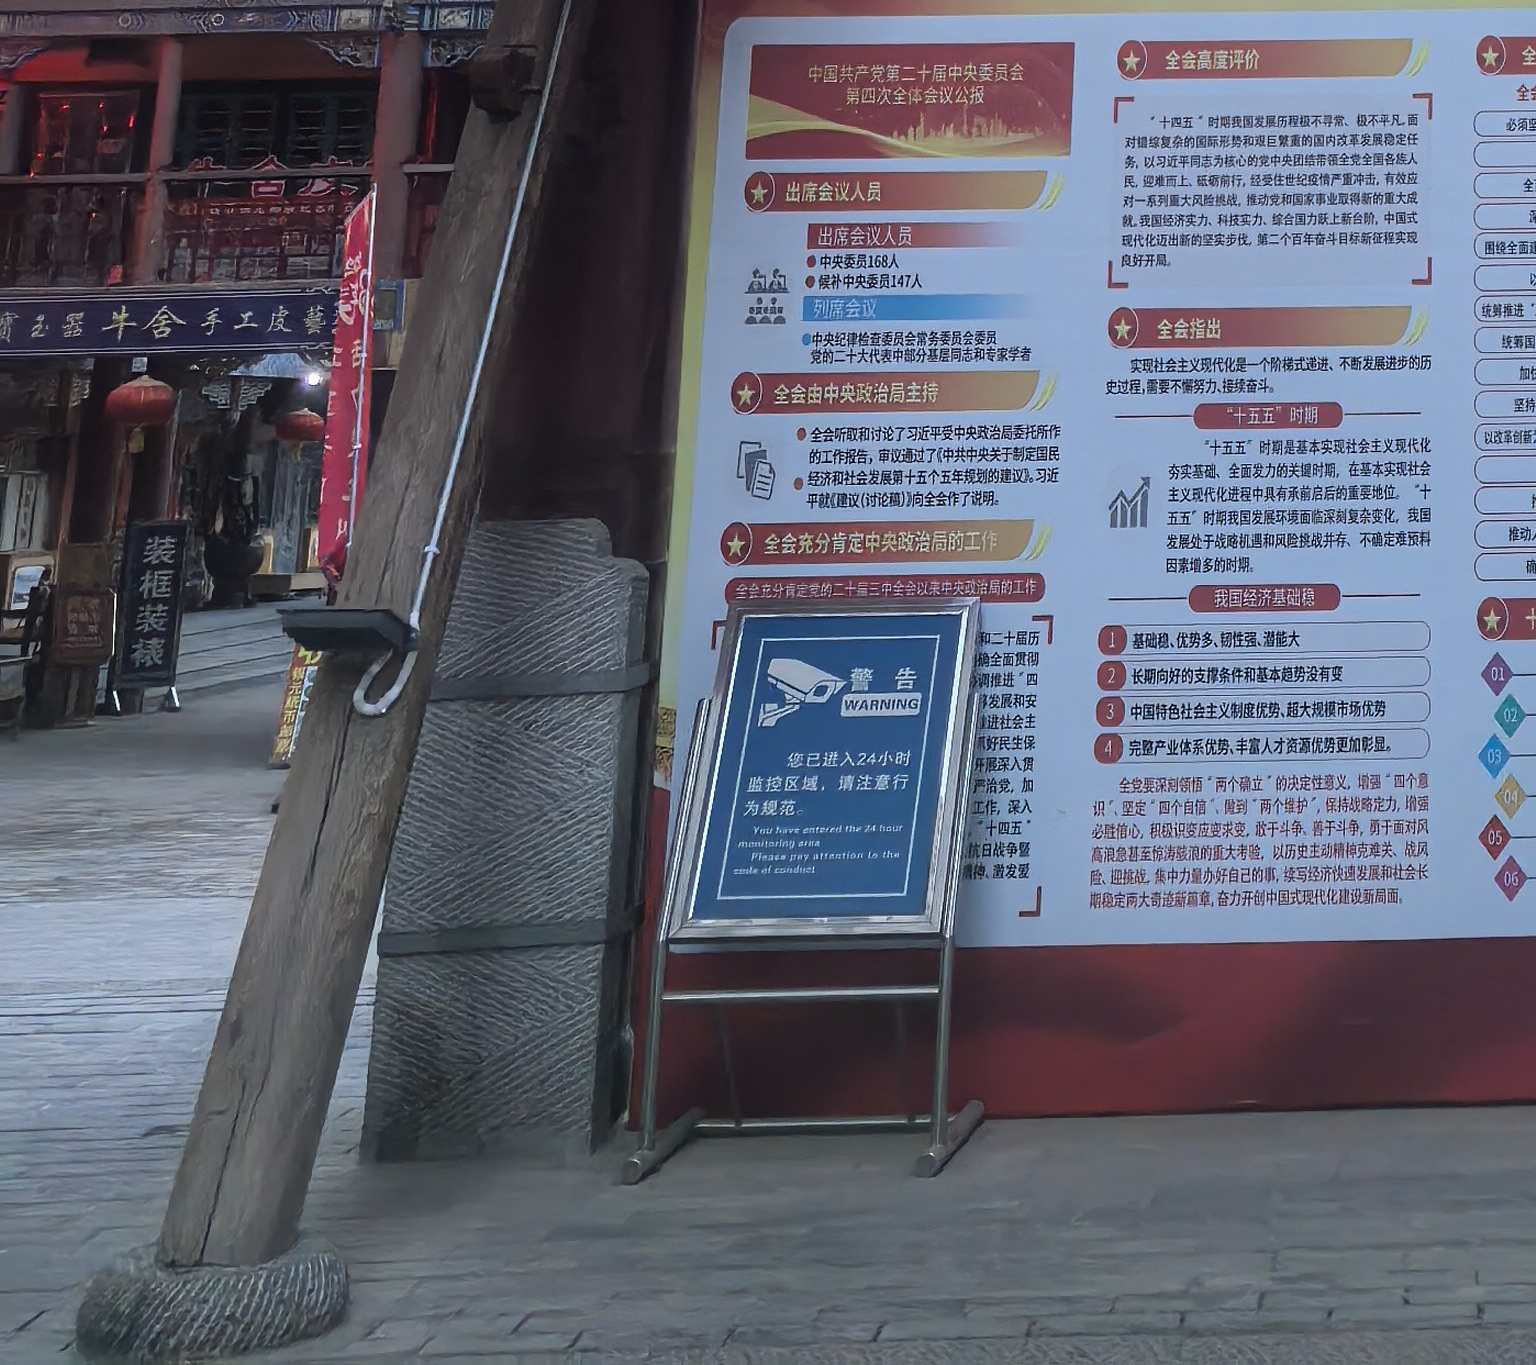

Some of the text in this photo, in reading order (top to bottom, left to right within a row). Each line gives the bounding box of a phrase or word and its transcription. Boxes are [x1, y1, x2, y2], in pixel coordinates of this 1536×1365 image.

[1165, 49, 1260, 70] 全会高度评价
[808, 63, 1024, 84] 中国共产党第二十届中央委员会
[846, 85, 985, 106] 第四次全体会议公报
[785, 181, 882, 203] 出席会议人员
[817, 225, 912, 247] 出席会议人员
[820, 254, 899, 270] 中央委员168人
[1120, 253, 1171, 268] 良好开局。
[818, 274, 923, 290] 候补中央委员147人
[812, 298, 878, 319] 列席会议
[811, 330, 997, 347] 中央纪律检查委员会常务委员会委员
[1157, 318, 1221, 341] 全会指出
[810, 346, 1032, 364] 党的二十大代表中部分基层同志和专家学者
[774, 382, 939, 405] 全会由中央政治局主持
[811, 425, 1061, 442] 全会听取和讨论了习近平受中央政治局委托所作
[763, 530, 998, 555] 全会充分肯定中央政治局的工作
[1166, 558, 1254, 573] 因素增多的时期。
[735, 579, 1037, 599] 全会充分肯定党的二十届三中全会以来中央政治局的工作
[1214, 588, 1315, 608] 我国经济基础稳
[129, 535, 178, 668] 装框装裱
[1109, 630, 1301, 650] 1 基础稳、优势多、韧性强、潜能大
[850, 667, 918, 693] 警告
[1107, 666, 1343, 685] 2 长期向好的支撑条件和基本趋势没有变
[1491, 668, 1505, 681] 01
[844, 698, 919, 712] WARNING
[1106, 701, 1386, 720] 3 中国特色社会主义制度优势、超大规模市场优势
[1503, 709, 1517, 723] 02
[1104, 737, 1392, 757] 4 完整产业体系优势、丰富人才资源优势更加彰显。
[787, 750, 911, 768] 您已进入24小时
[1487, 750, 1501, 763] 03
[747, 774, 909, 792] 监控区域，请注意行
[1503, 789, 1519, 804] 04
[743, 800, 804, 817] 为规范。
[753, 826, 772, 835] You
[775, 826, 799, 834] have
[803, 825, 842, 834] entered
[845, 825, 862, 833] the
[864, 825, 876, 833] 24
[1488, 830, 1503, 845] 05
[738, 839, 795, 849] monitoring
[751, 850, 900, 862] Please pay attention to the
[761, 865, 771, 874] of
[774, 866, 815, 874] conduct
[1503, 872, 1519, 887] 06
